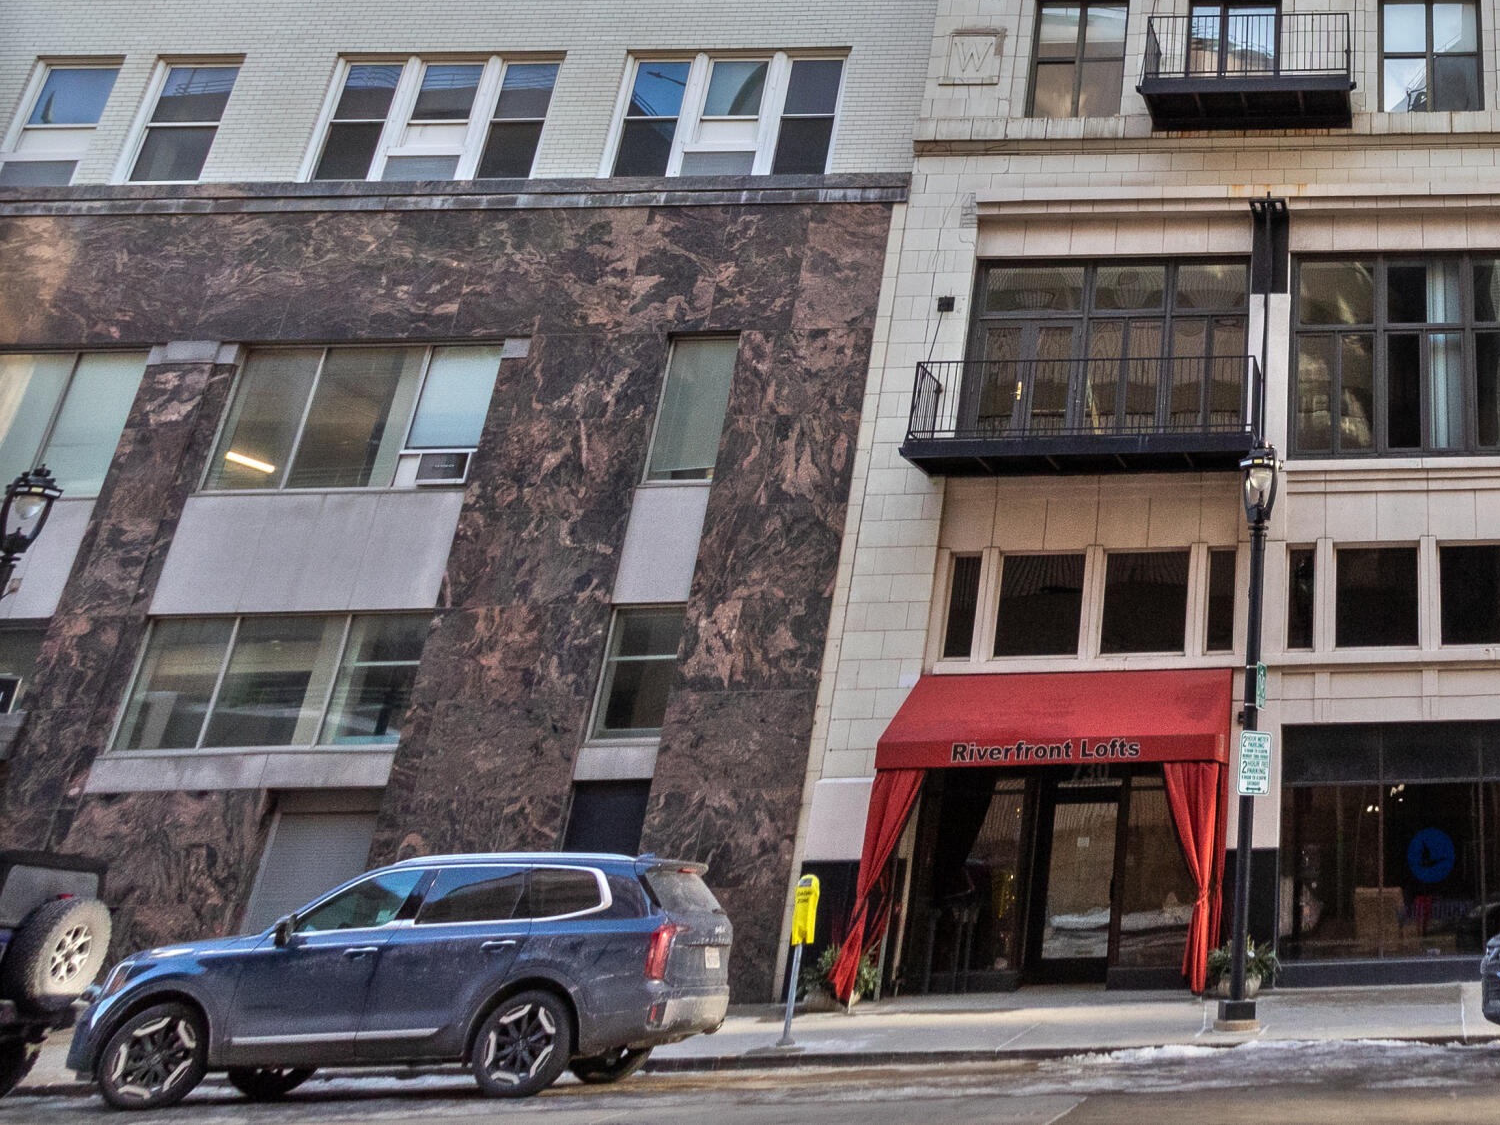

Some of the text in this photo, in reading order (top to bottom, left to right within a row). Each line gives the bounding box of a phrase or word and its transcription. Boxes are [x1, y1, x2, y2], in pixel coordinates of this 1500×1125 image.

[954, 42, 993, 72] W
[951, 738, 1140, 763] Riverfront Lofts
[1242, 761, 1247, 773] 2
